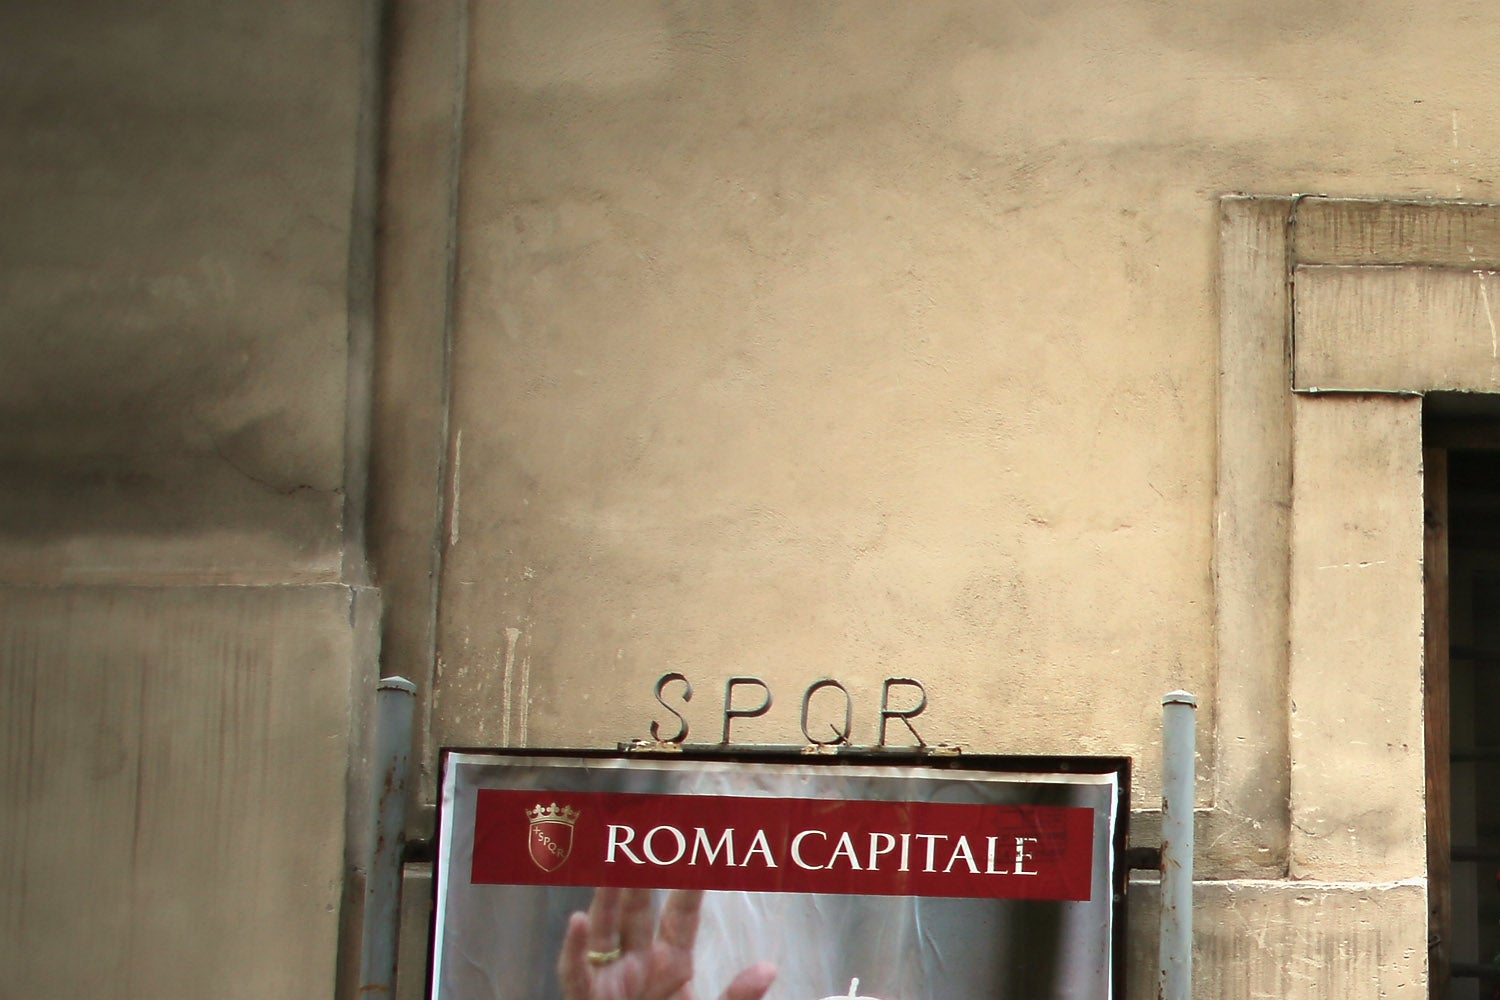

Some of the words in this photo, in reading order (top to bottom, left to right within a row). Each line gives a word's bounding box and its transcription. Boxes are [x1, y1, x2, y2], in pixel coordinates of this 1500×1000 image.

[649, 672, 929, 747] SPQR
[538, 831, 565, 858] SPQR
[605, 824, 779, 869] ROMA
[791, 831, 1039, 877] CAPITALE
